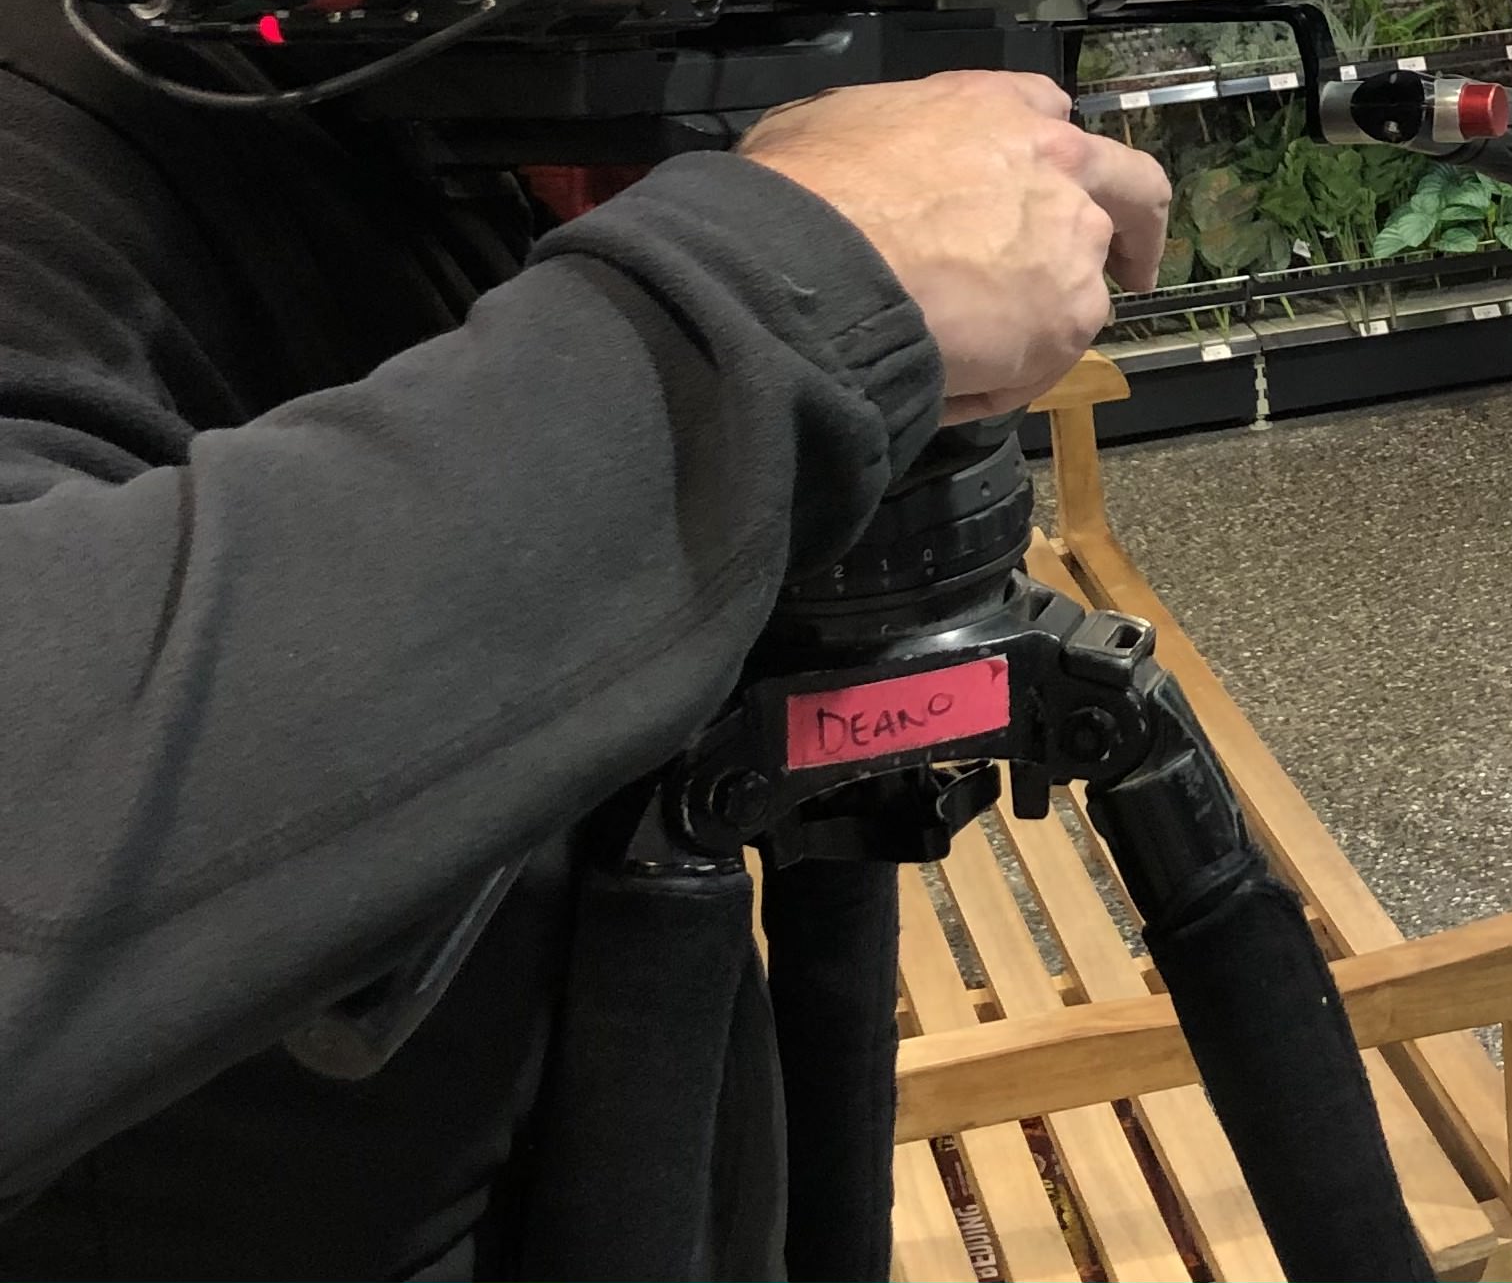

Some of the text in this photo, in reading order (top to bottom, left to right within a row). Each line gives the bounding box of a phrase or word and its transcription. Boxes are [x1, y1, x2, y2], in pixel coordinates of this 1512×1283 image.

[832, 564, 844, 578] 2
[880, 558, 888, 571] 1
[816, 692, 954, 755] DEANO
[954, 1203, 999, 1280] BEDDING
